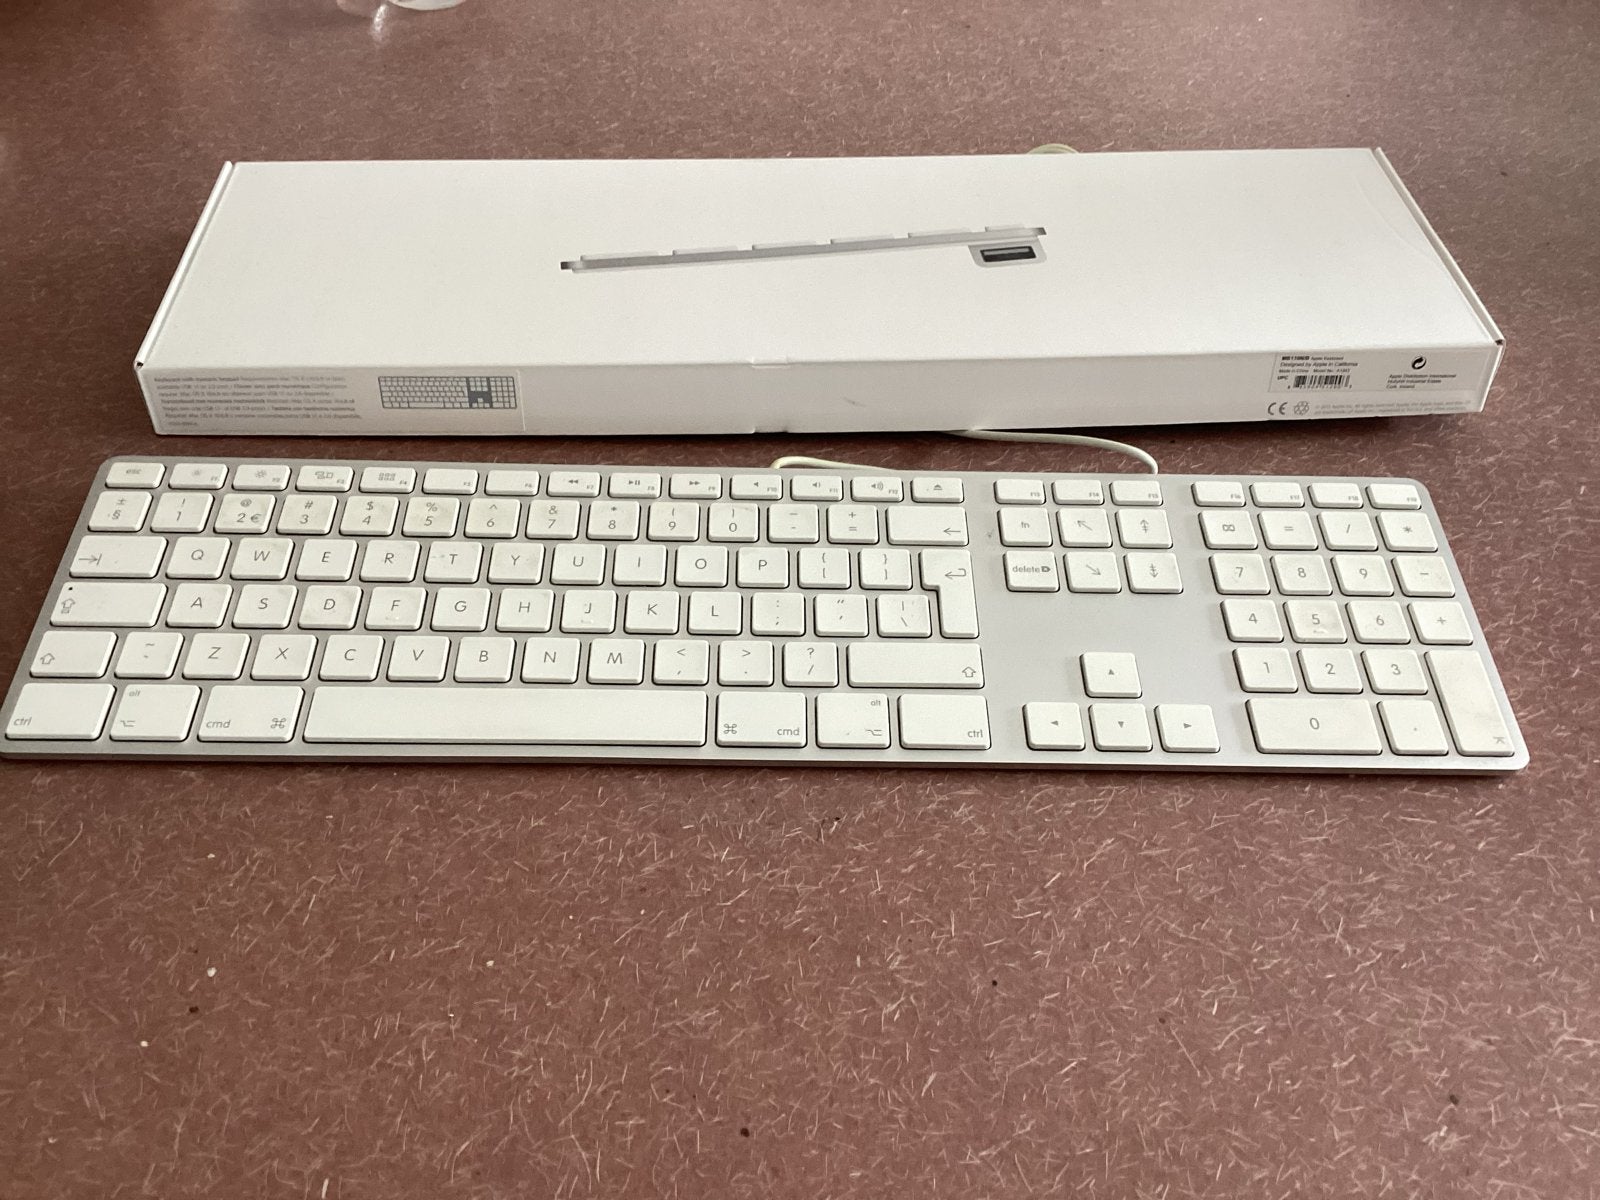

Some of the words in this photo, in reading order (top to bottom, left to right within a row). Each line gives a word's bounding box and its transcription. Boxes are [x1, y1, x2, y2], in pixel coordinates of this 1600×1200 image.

[304, 500, 314, 510] #
[365, 500, 374, 512] $
[425, 501, 439, 513] %
[548, 504, 559, 516] &
[176, 510, 182, 522] 1
[236, 512, 247, 524] 2
[249, 513, 262, 524] €
[299, 513, 310, 525] 3
[361, 515, 372, 526] 4
[423, 515, 434, 527] 5
[486, 517, 495, 528] 6
[548, 518, 557, 529] 7
[607, 519, 617, 530] 8
[668, 520, 677, 531] 9
[1020, 521, 1030, 529] fn
[190, 548, 205, 561] Q
[253, 550, 271, 562] W
[321, 551, 331, 563] E
[384, 552, 395, 564] R
[448, 553, 459, 565] T
[510, 554, 521, 566] Y
[572, 555, 585, 568] U
[758, 559, 768, 571] P
[1012, 565, 1039, 573] delete
[1235, 566, 1244, 578] 7
[1297, 567, 1307, 579] 8
[1358, 567, 1368, 580] 9
[190, 596, 203, 609] A
[257, 597, 269, 610] S
[323, 598, 336, 611] D
[390, 599, 401, 611] F
[454, 600, 467, 613] G
[518, 601, 531, 613] H
[584, 602, 592, 615] J
[646, 603, 658, 616] K
[711, 605, 719, 617] L
[1248, 612, 1259, 625] 4
[1311, 613, 1321, 626] 5
[1375, 614, 1385, 627] 6
[207, 646, 222, 660] Z
[274, 647, 289, 660] X
[344, 648, 357, 662] C
[412, 649, 425, 662] V
[478, 649, 489, 663] B
[543, 650, 557, 664] N
[606, 652, 623, 665] M
[806, 647, 815, 659] ?
[1262, 661, 1271, 674] 1
[1324, 662, 1336, 675] 2
[1390, 663, 1402, 676] 3
[128, 689, 142, 697] alt
[870, 699, 882, 707] alt
[13, 716, 33, 726] ctrl
[205, 719, 232, 729] cmd
[1309, 717, 1320, 731] 0
[776, 727, 801, 737] cmd
[967, 729, 984, 738] ctrl
